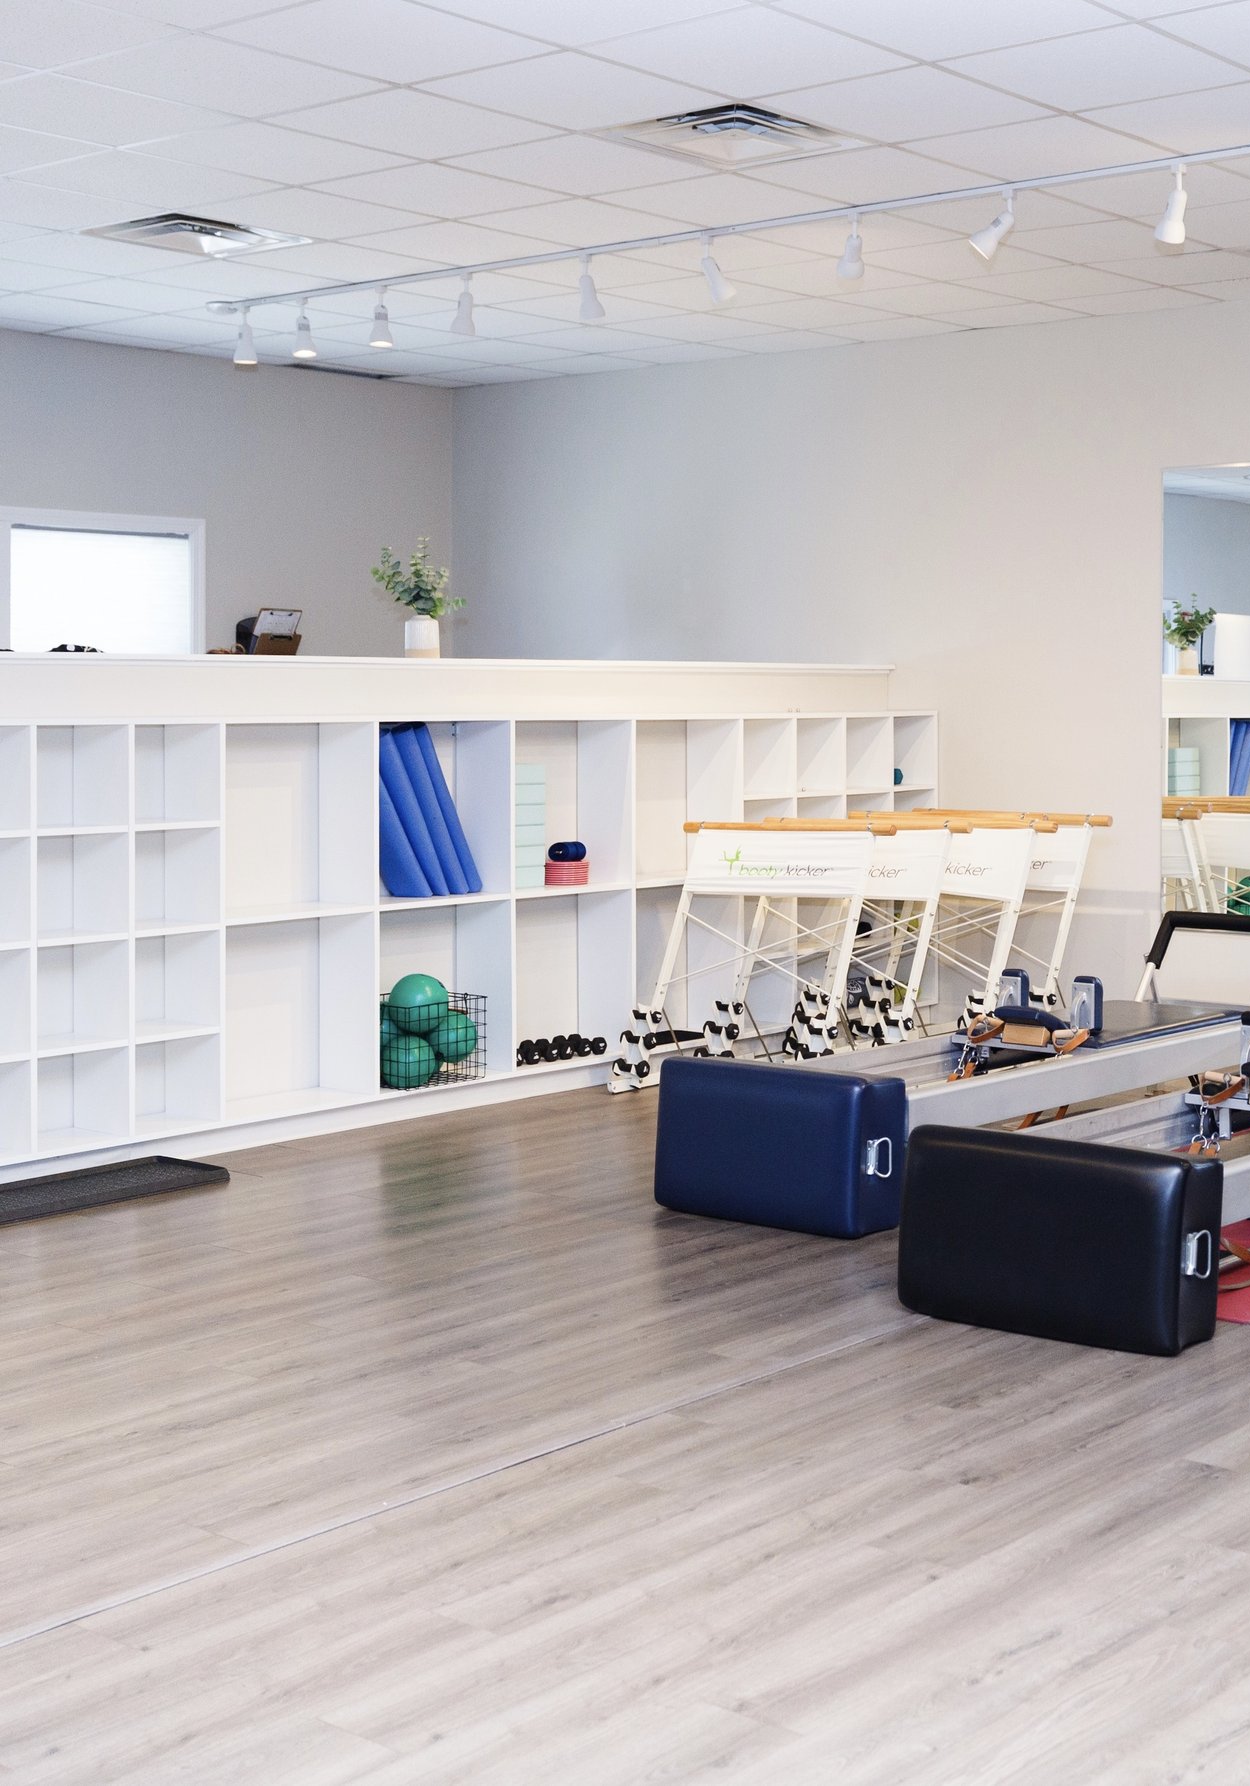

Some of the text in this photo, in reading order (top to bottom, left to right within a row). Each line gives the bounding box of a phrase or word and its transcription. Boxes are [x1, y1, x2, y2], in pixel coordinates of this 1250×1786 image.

[739, 864, 832, 879] booty kicker
[868, 865, 905, 878] icker
[945, 861, 989, 876] kicker
